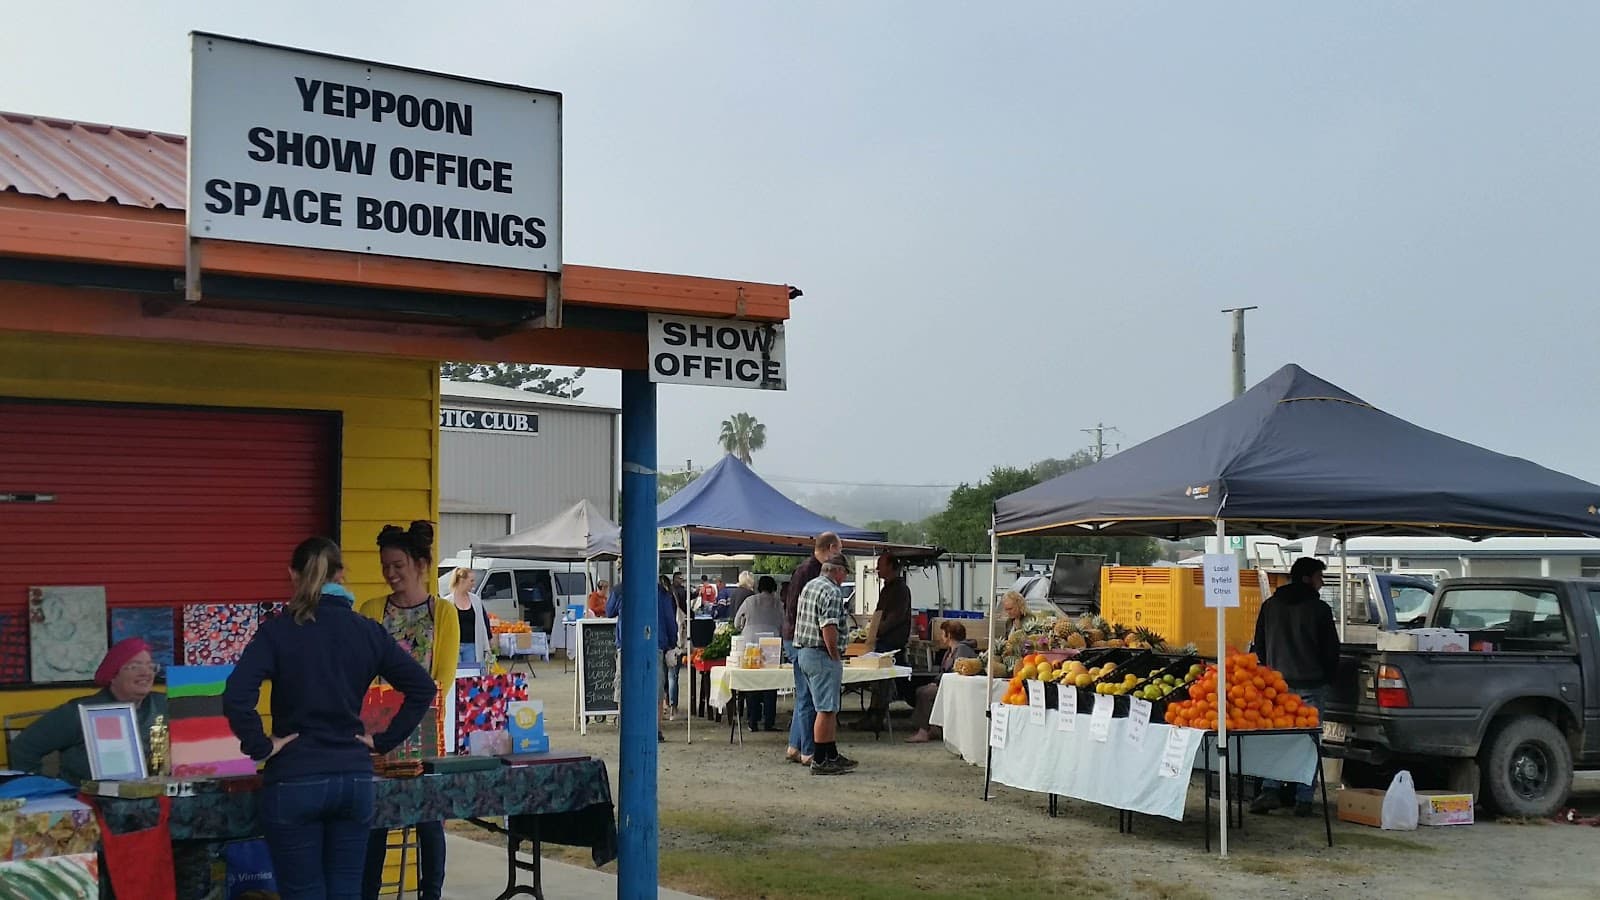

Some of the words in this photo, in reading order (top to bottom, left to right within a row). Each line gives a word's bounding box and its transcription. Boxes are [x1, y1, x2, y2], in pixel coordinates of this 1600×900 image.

[294, 76, 473, 136] YEPPOON
[247, 127, 377, 176] SHOW
[389, 147, 513, 194] OFFICE
[204, 178, 343, 227] SPACE
[356, 196, 547, 249] BOOKINGS
[663, 322, 768, 352] SHOW
[654, 352, 782, 384] OFFICE
[1211, 576, 1232, 584] Byfield
[1213, 587, 1231, 595] Citrus
